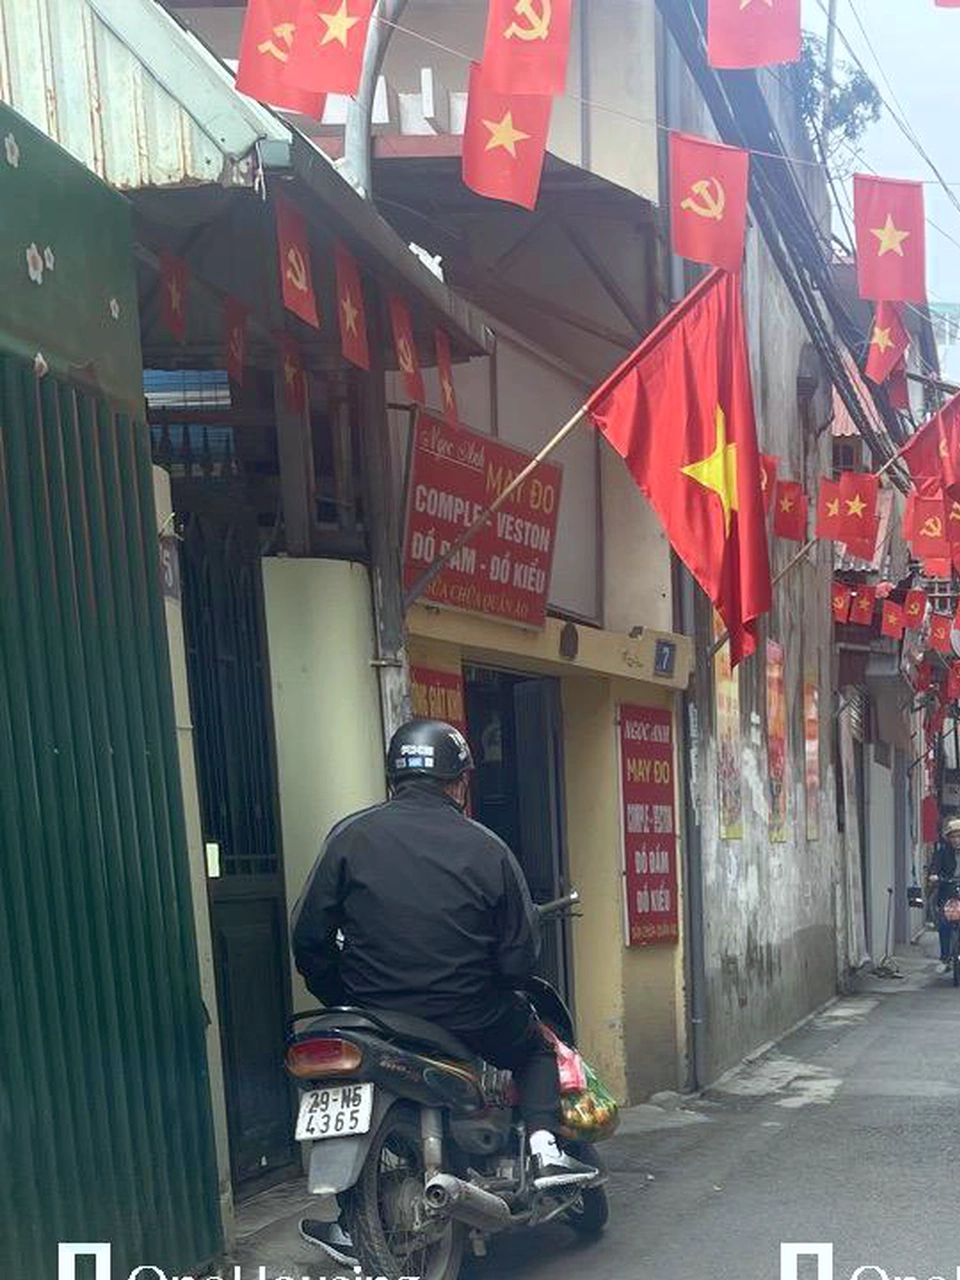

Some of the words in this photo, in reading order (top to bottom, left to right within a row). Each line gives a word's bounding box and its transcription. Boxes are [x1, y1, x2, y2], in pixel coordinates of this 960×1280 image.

[497, 511, 551, 552] VESTON
[626, 757, 652, 783] MAY
[305, 1109, 360, 1135] 4365
